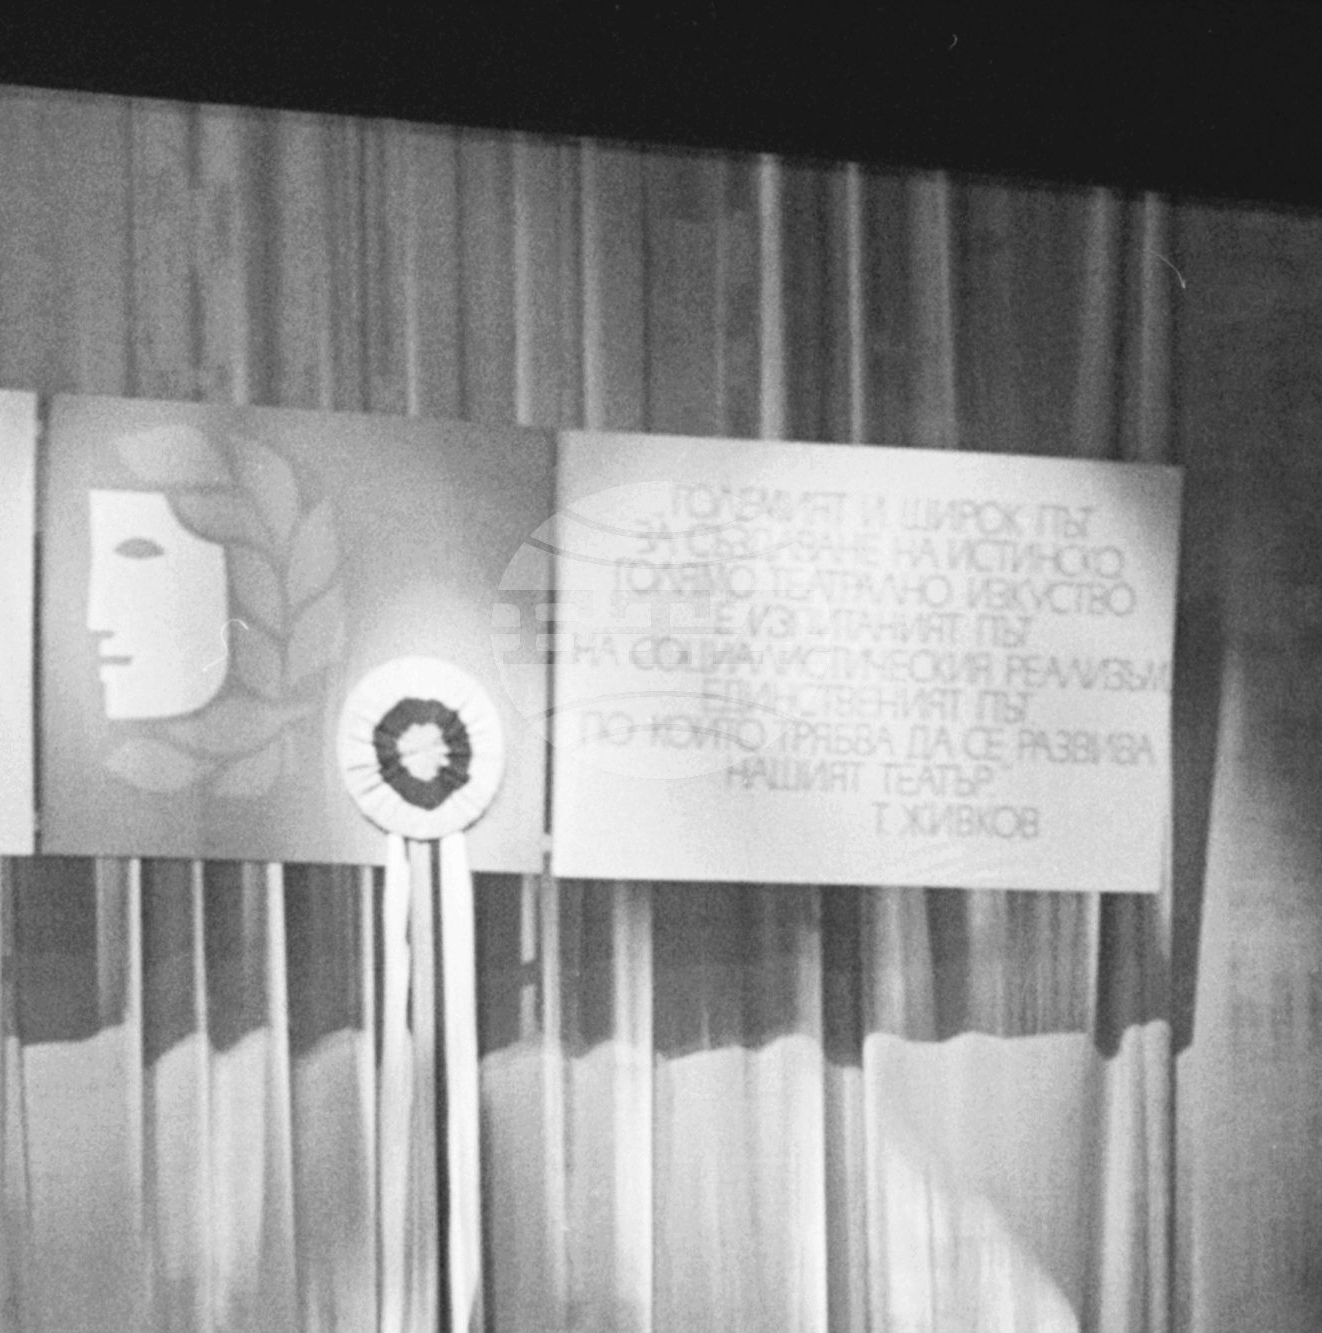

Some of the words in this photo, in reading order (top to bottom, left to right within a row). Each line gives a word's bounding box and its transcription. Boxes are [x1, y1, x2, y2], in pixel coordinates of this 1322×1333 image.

[899, 497, 1024, 538] ШИРОК
[1036, 503, 1094, 540] ПЪТ
[895, 536, 941, 571] НА
[946, 538, 1125, 580] ИСТИНСКО
[977, 613, 1032, 649] ПЪТ
[977, 689, 1033, 724] ПЪТ
[906, 724, 954, 761] ДА
[963, 725, 1005, 762] СЕ
[900, 802, 1041, 841] ЖИВКОВ
